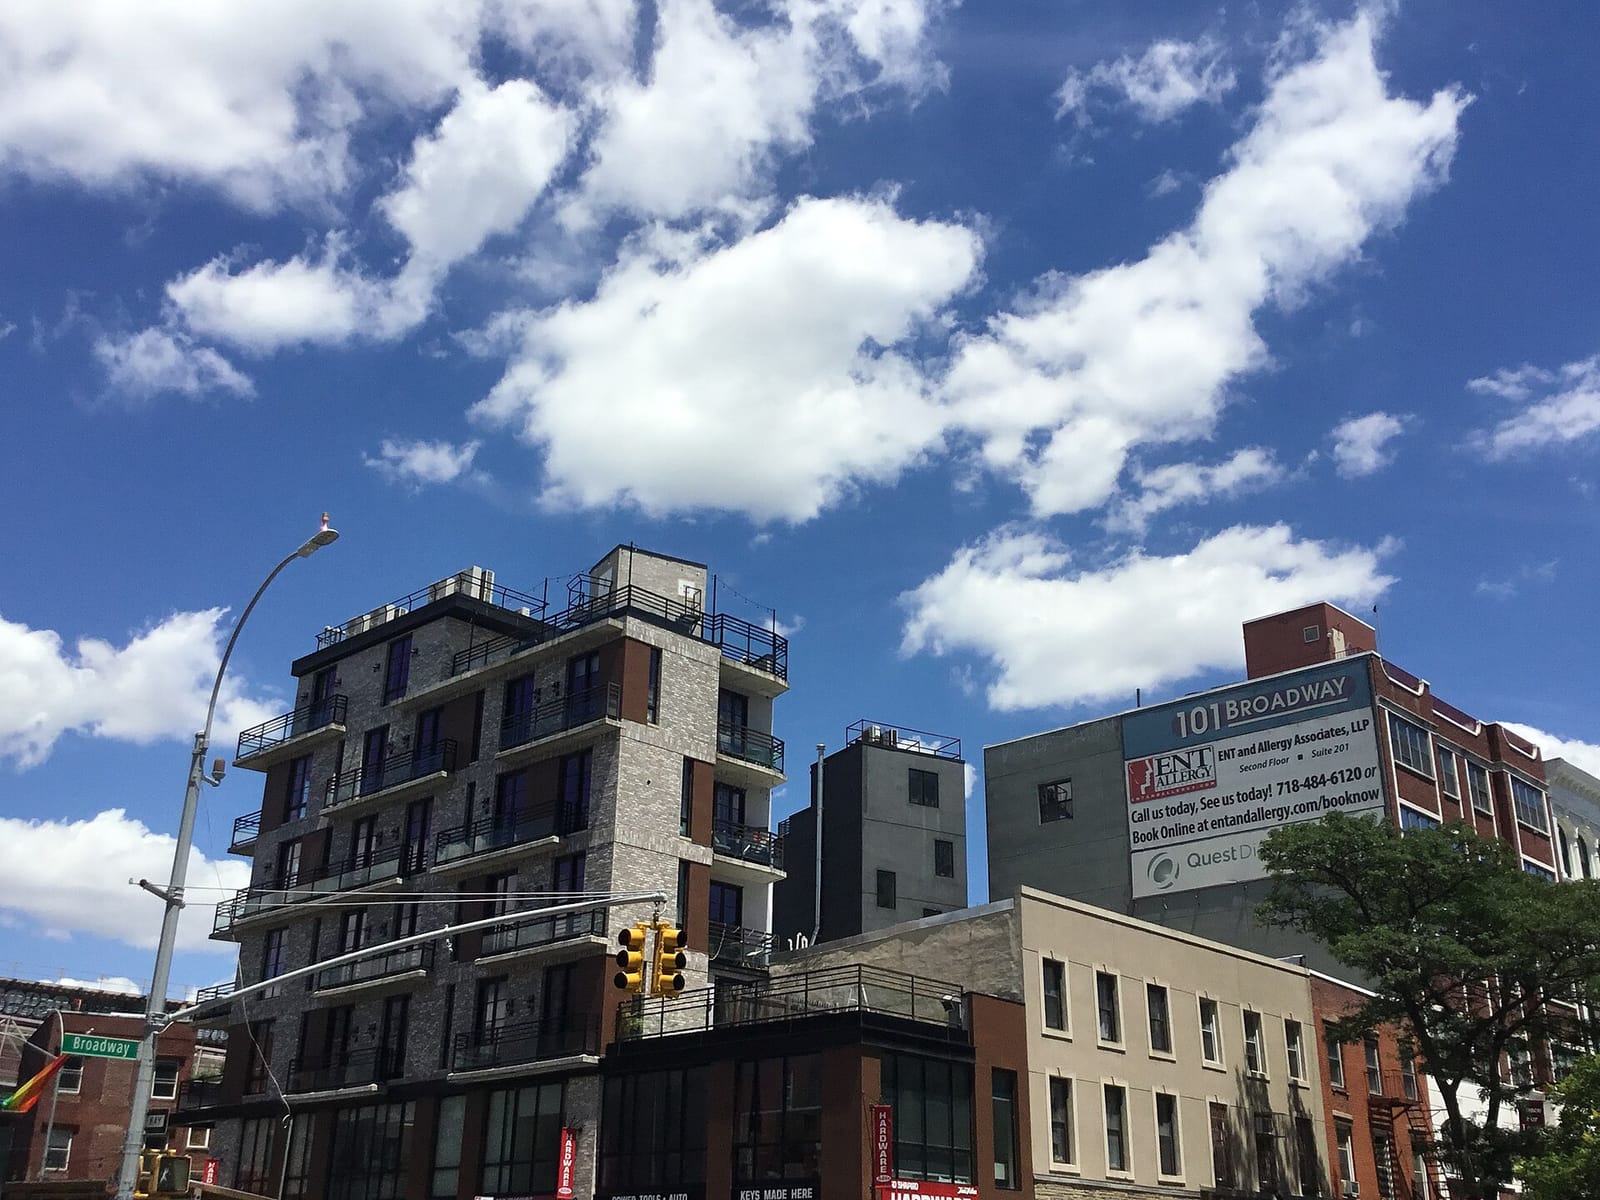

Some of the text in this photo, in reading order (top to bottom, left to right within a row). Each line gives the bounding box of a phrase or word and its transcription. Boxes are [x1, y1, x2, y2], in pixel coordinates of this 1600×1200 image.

[1176, 677, 1346, 738] 101 BROADWAY
[1218, 719, 1370, 762] ENT and Allergy Associates, LLP
[1311, 743, 1350, 759] Suite 201
[1154, 747, 1212, 777] ENT
[1156, 765, 1212, 787] ALLERGY
[1239, 755, 1290, 773] Second Floor
[1131, 765, 1377, 824] Call us today, See us today! 718-484-6120 or
[1132, 788, 1380, 844] Book Online at entandallergy.com/booknow
[1187, 846, 1238, 868] Quest
[73, 1036, 130, 1057] Broadway
[878, 1111, 888, 1173] HARDWARE
[562, 1133, 573, 1187] HARDWARE
[740, 1187, 813, 1200] KEYS MADE HERE
